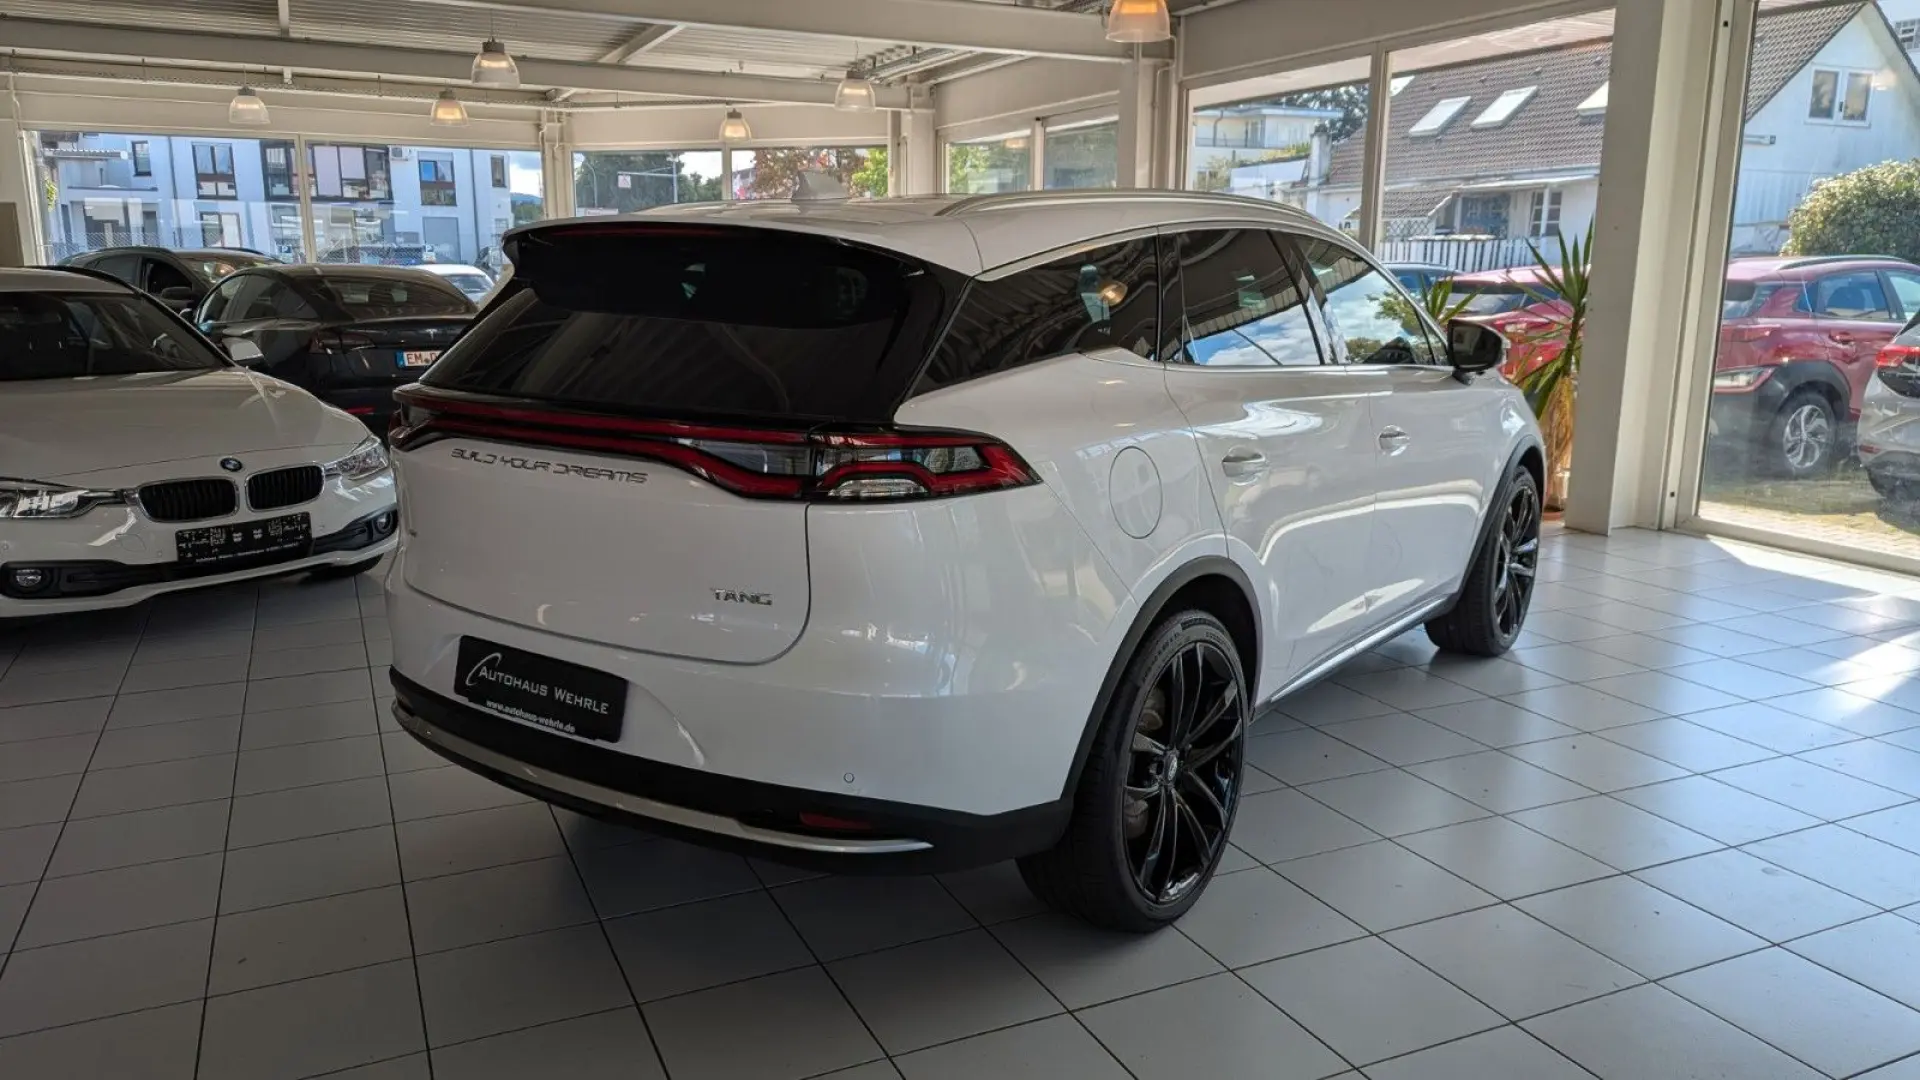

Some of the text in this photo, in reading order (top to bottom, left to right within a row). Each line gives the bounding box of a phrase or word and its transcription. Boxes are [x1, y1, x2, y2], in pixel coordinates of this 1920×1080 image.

[451, 449, 649, 483] BUILD YOUR DREAMS
[712, 588, 773, 606] TANG
[479, 666, 609, 715] AUTOHAUS WEHRLE
[486, 700, 576, 733] www.autohaus-wehrle.de
